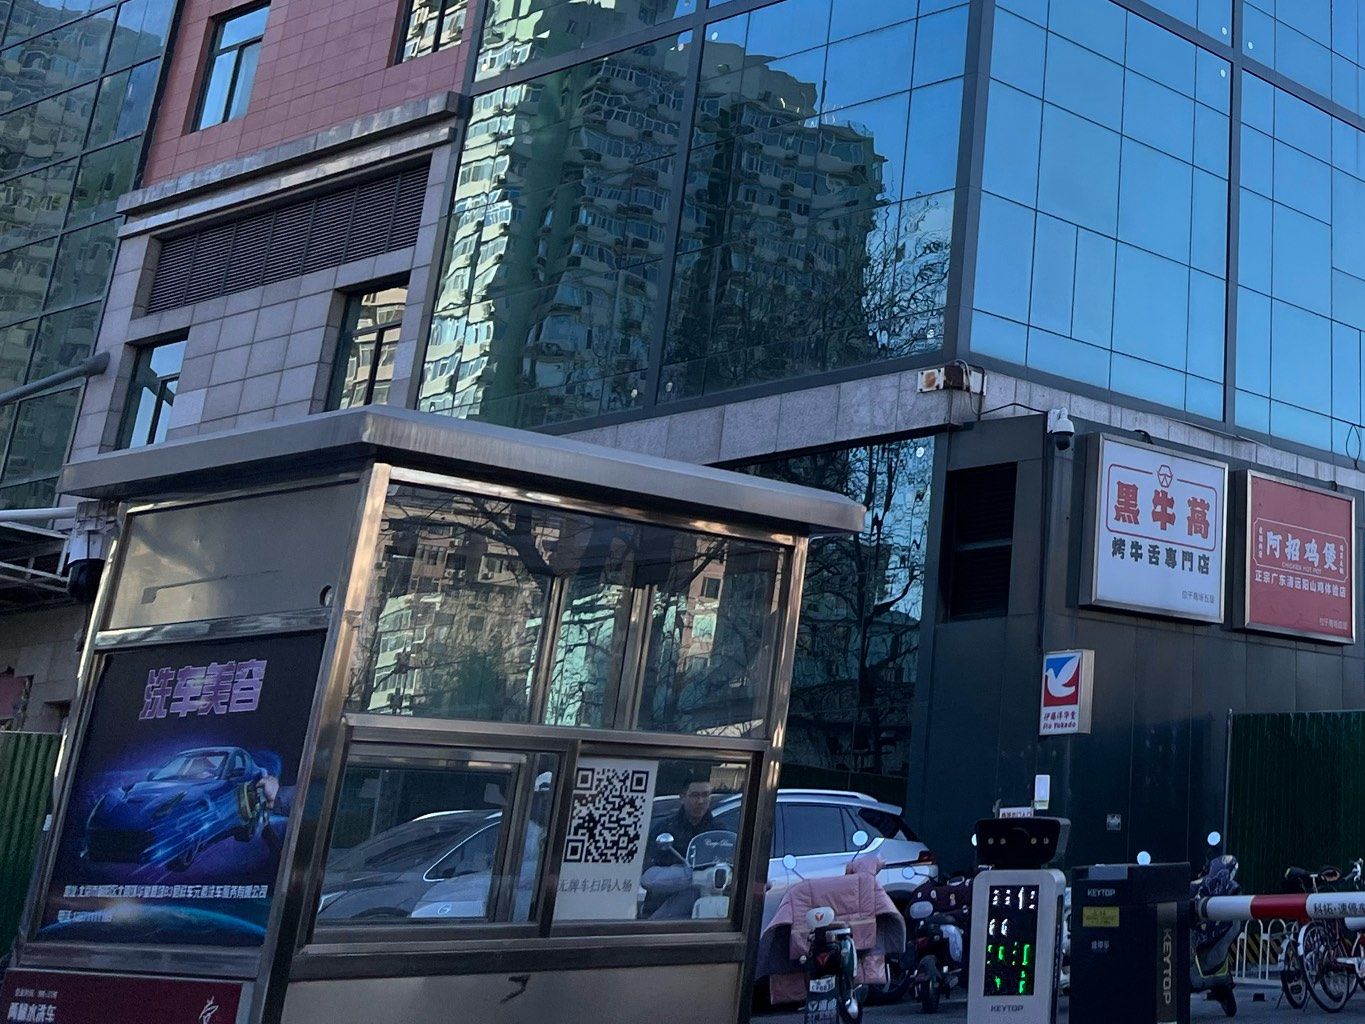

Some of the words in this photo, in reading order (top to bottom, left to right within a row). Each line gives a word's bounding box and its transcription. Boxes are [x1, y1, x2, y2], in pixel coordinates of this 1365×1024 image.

[1266, 531, 1337, 571] 阿招鸡煲
[138, 659, 268, 720] 洗车美容
[558, 878, 633, 894] 无牌车扫码入场
[1087, 888, 1115, 897] KEYTOP
[1162, 927, 1173, 1005] KEYTOP
[990, 1004, 1024, 1013] KEYTOP
